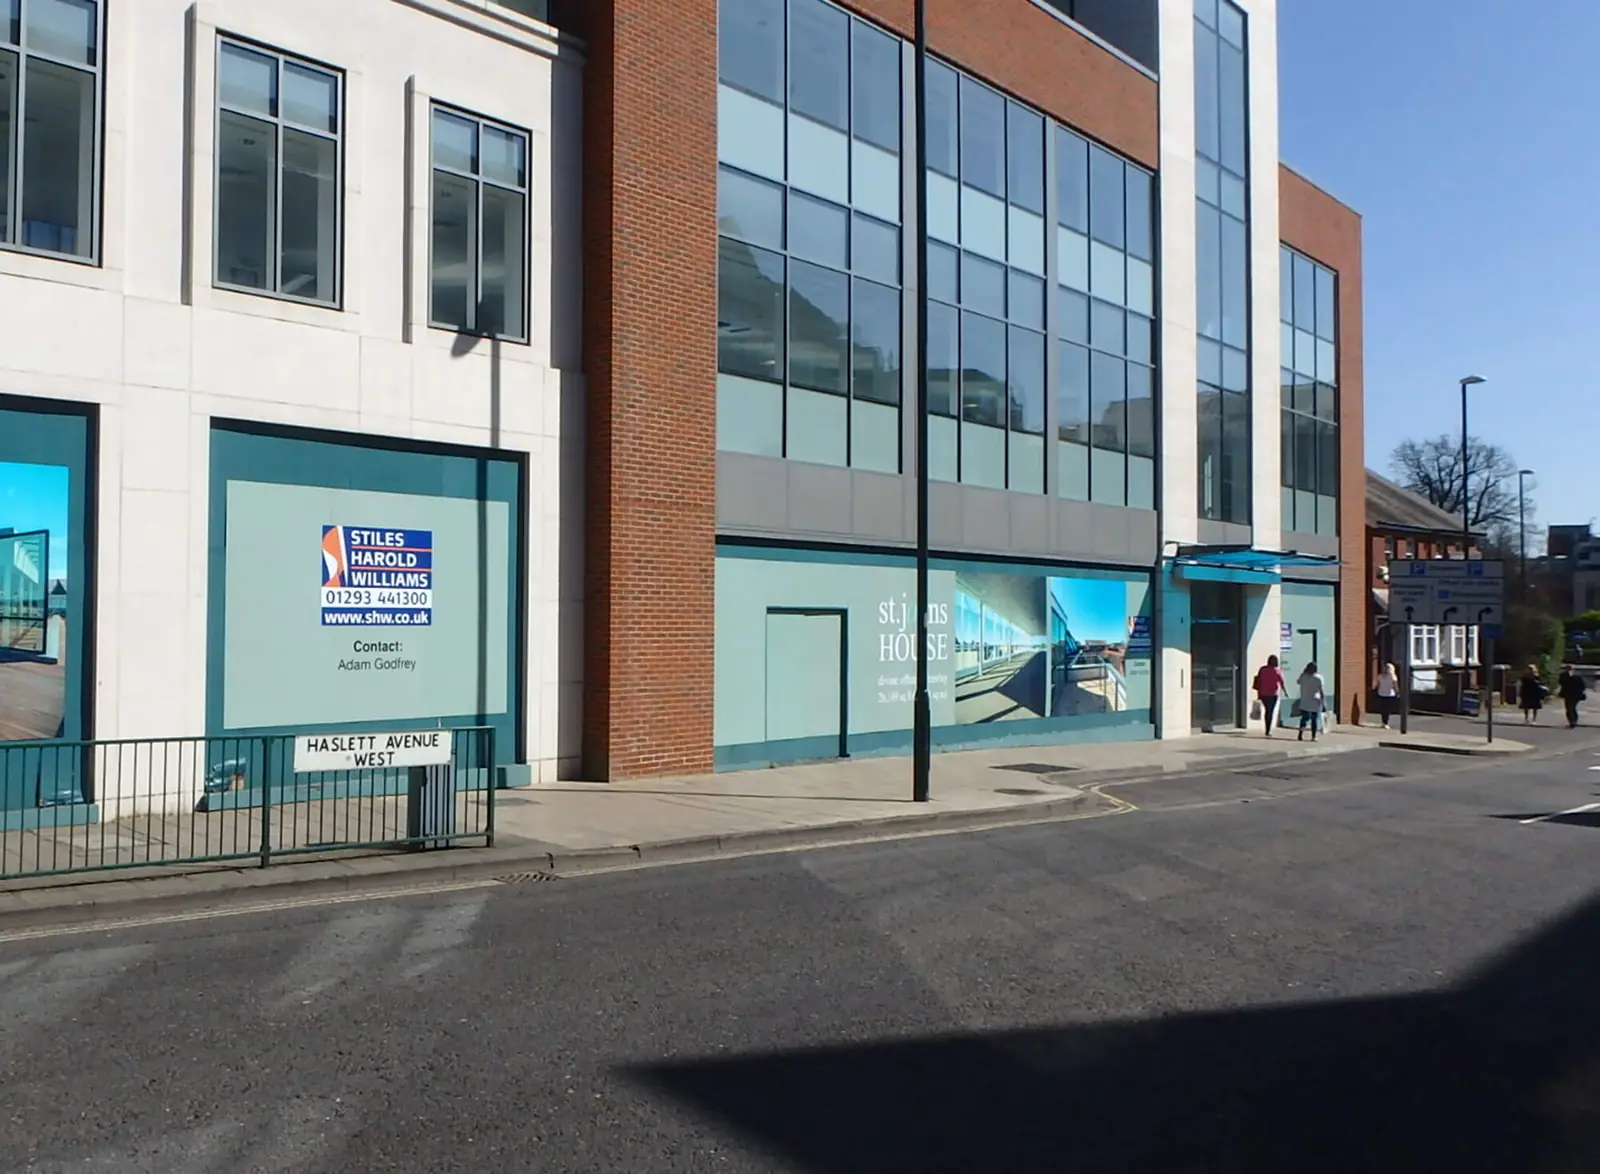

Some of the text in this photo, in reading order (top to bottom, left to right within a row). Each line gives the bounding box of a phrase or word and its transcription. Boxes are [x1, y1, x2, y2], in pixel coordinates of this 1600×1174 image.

[351, 530, 404, 547] STILES
[351, 551, 417, 567] HAROLD
[352, 571, 428, 587] WILLIAMS
[326, 590, 428, 605] 01293 441300
[324, 610, 429, 624] www.shw.co.uk
[878, 592, 948, 633] st.jns
[353, 640, 403, 653] Contact:
[337, 657, 416, 671] Adam Godfrey
[307, 733, 440, 752] HASLETT AVENUE
[354, 751, 395, 766] WEST
